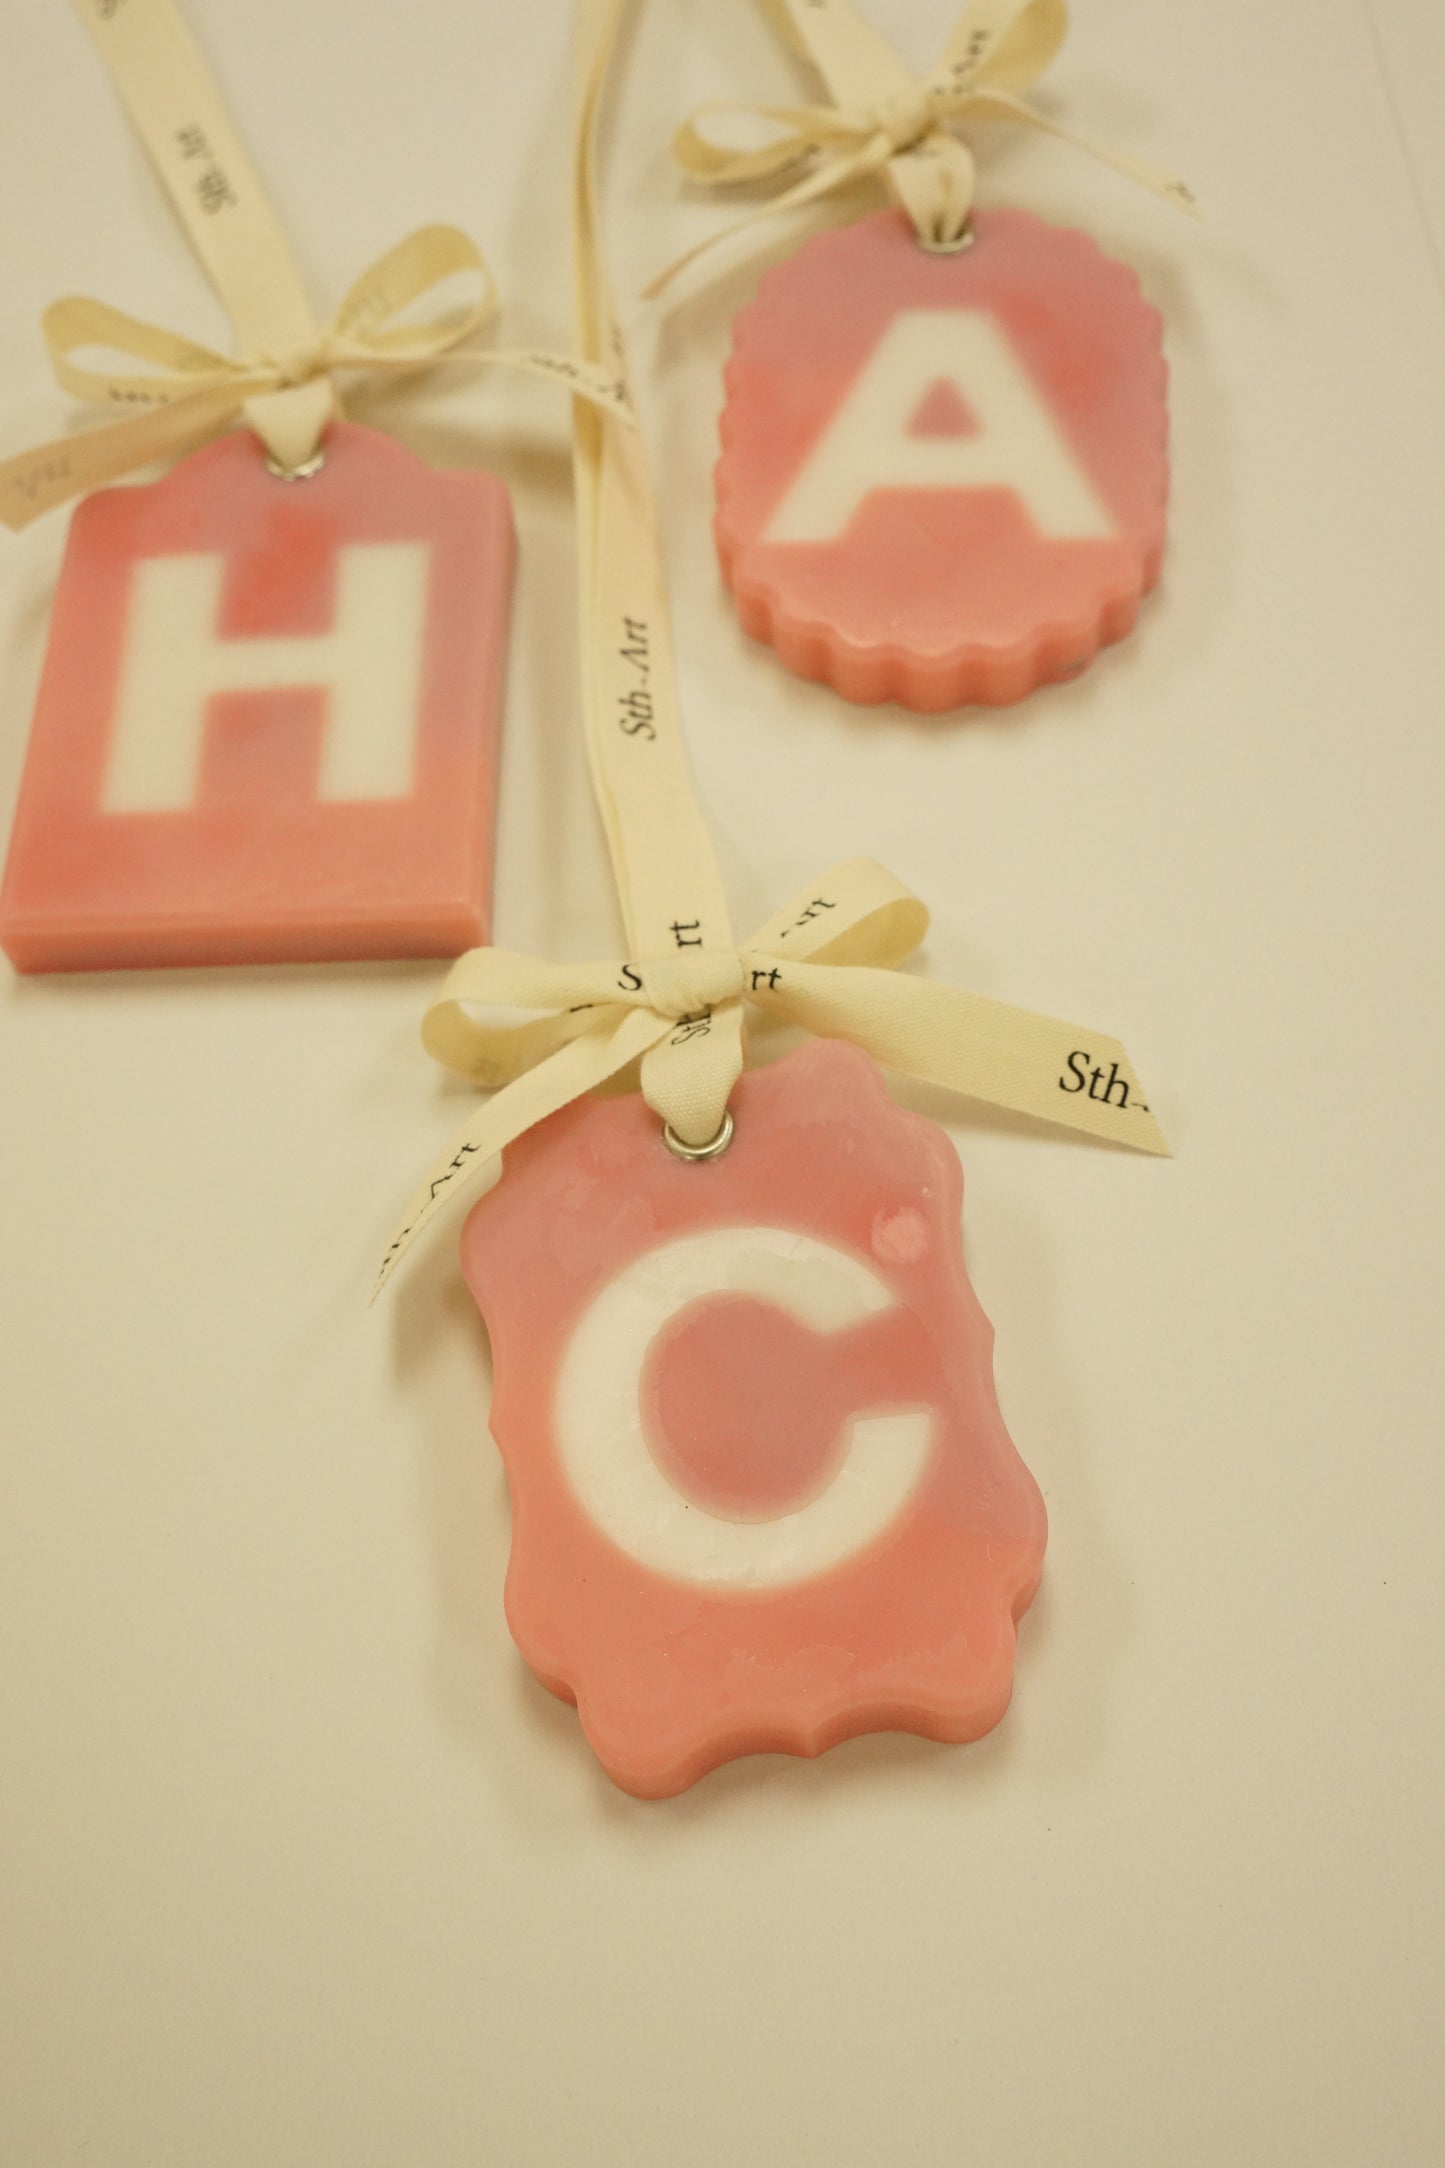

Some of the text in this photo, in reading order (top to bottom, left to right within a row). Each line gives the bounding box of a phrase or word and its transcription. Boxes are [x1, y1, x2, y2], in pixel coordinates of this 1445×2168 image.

[760, 307, 1122, 543] A
[99, 542, 431, 818] H
[618, 616, 657, 741] Sth-Art
[556, 1226, 934, 1592] C
